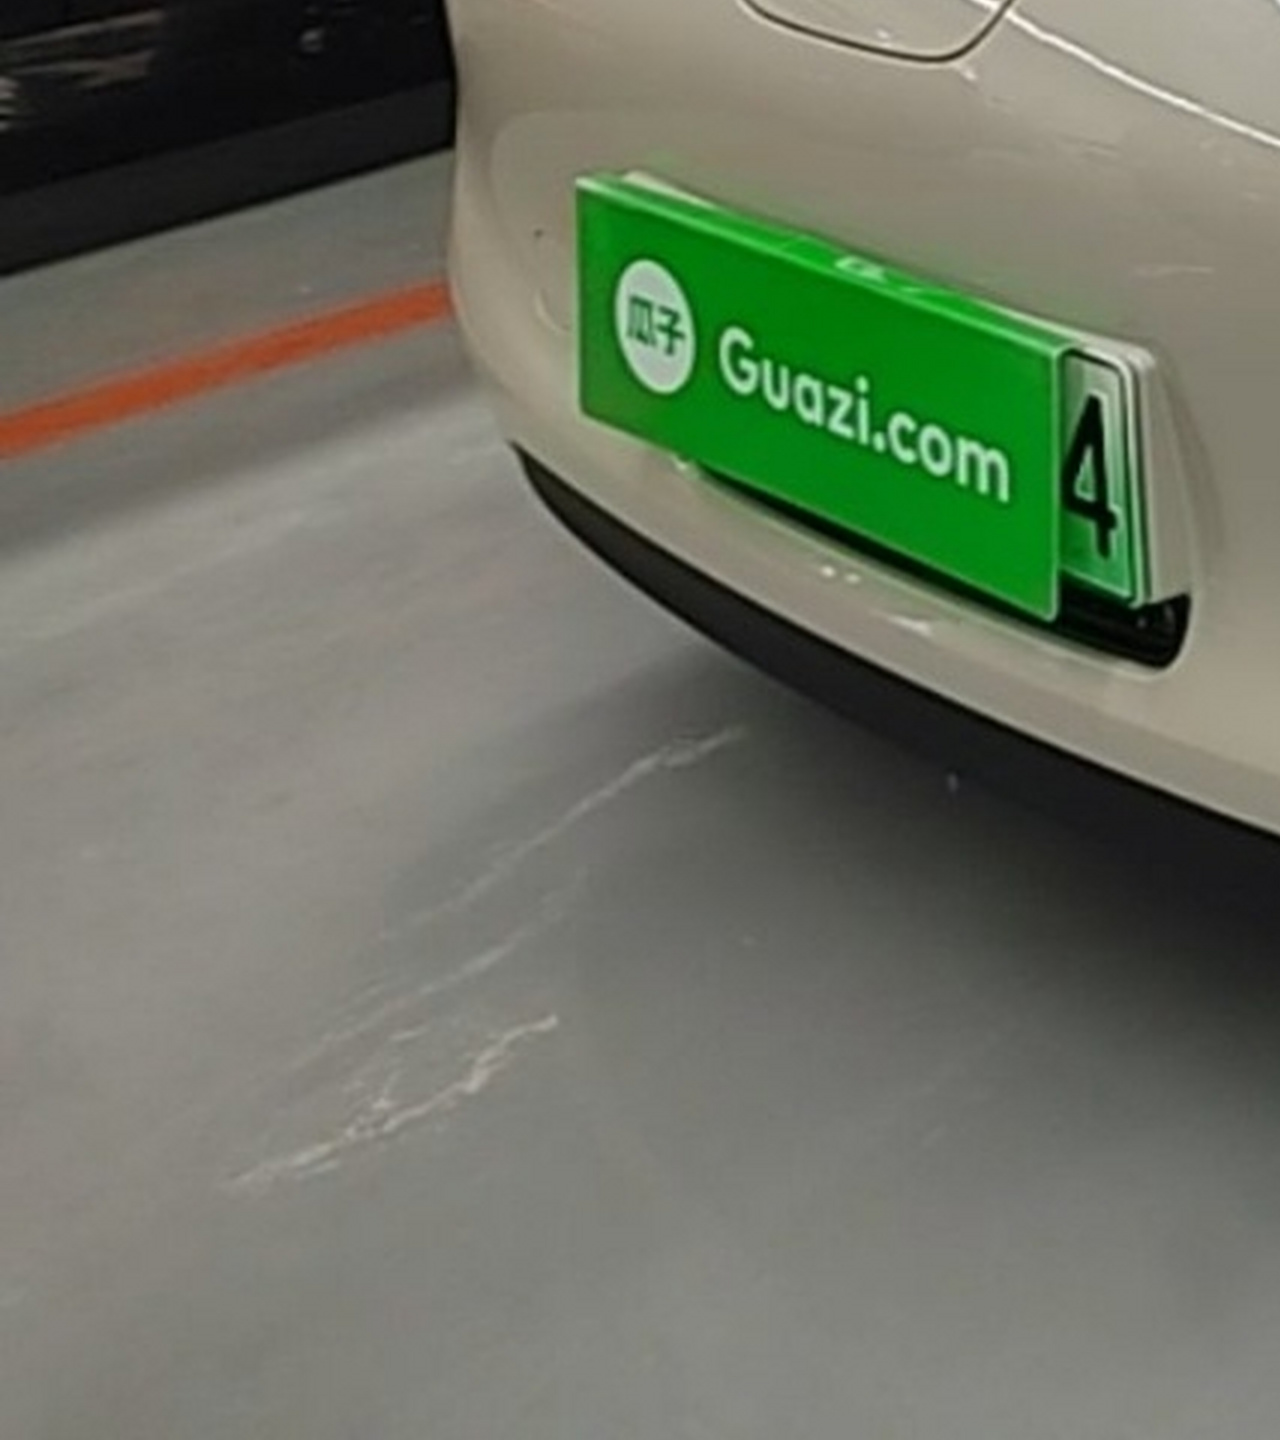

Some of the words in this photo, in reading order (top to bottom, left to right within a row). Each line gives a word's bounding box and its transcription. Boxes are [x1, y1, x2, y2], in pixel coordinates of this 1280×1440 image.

[627, 294, 686, 357] 瓜子
[718, 326, 1010, 503] Guazi.com
[1061, 392, 1119, 561] 4
